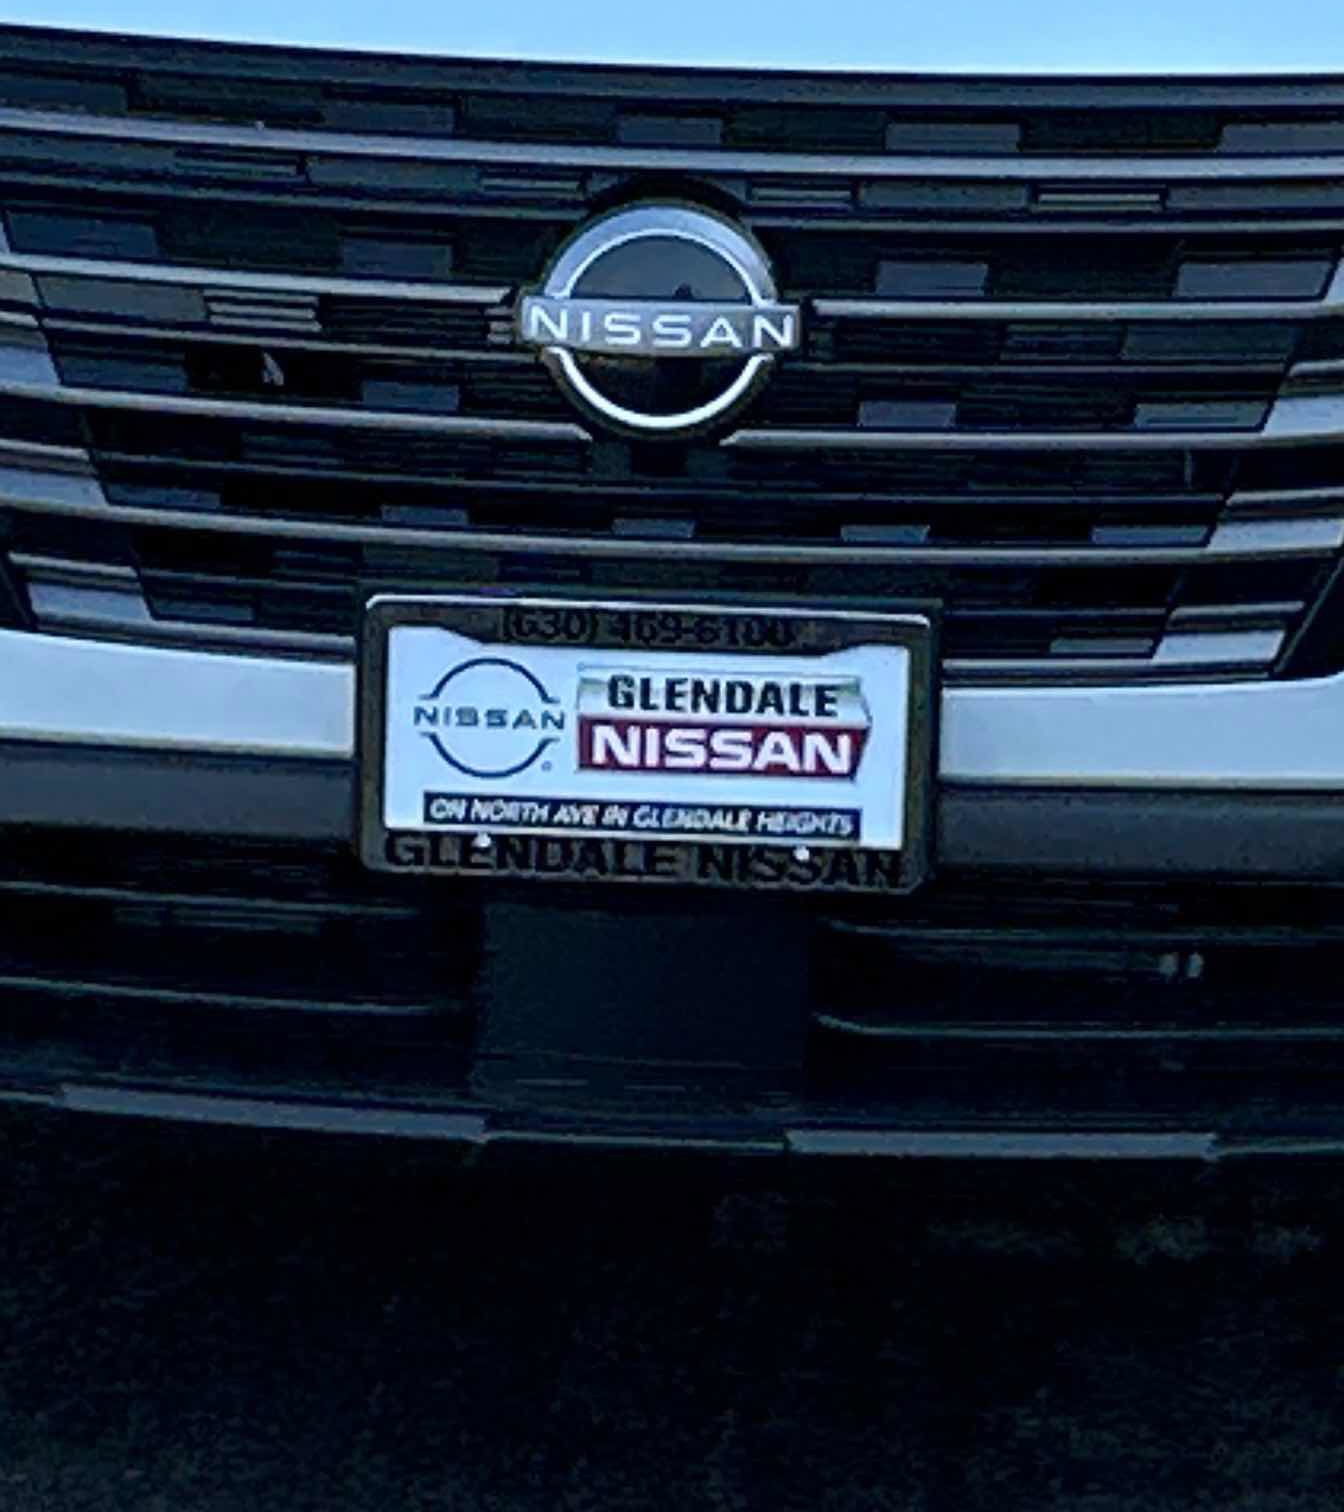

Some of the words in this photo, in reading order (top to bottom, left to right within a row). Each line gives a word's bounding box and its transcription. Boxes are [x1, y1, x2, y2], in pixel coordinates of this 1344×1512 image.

[528, 305, 795, 349] NISSAN
[413, 704, 566, 731] NISSAN
[607, 674, 839, 718] GLENDALE
[591, 726, 853, 774] NISSAN
[429, 797, 467, 820] ON
[470, 798, 550, 823] NORTH
[552, 802, 599, 826] AVE
[601, 804, 629, 827] IN
[632, 804, 753, 832] GLENDALE
[756, 809, 853, 836] HEIGHTS
[386, 833, 678, 878] GLENDALE
[696, 845, 906, 888] NISSAN
